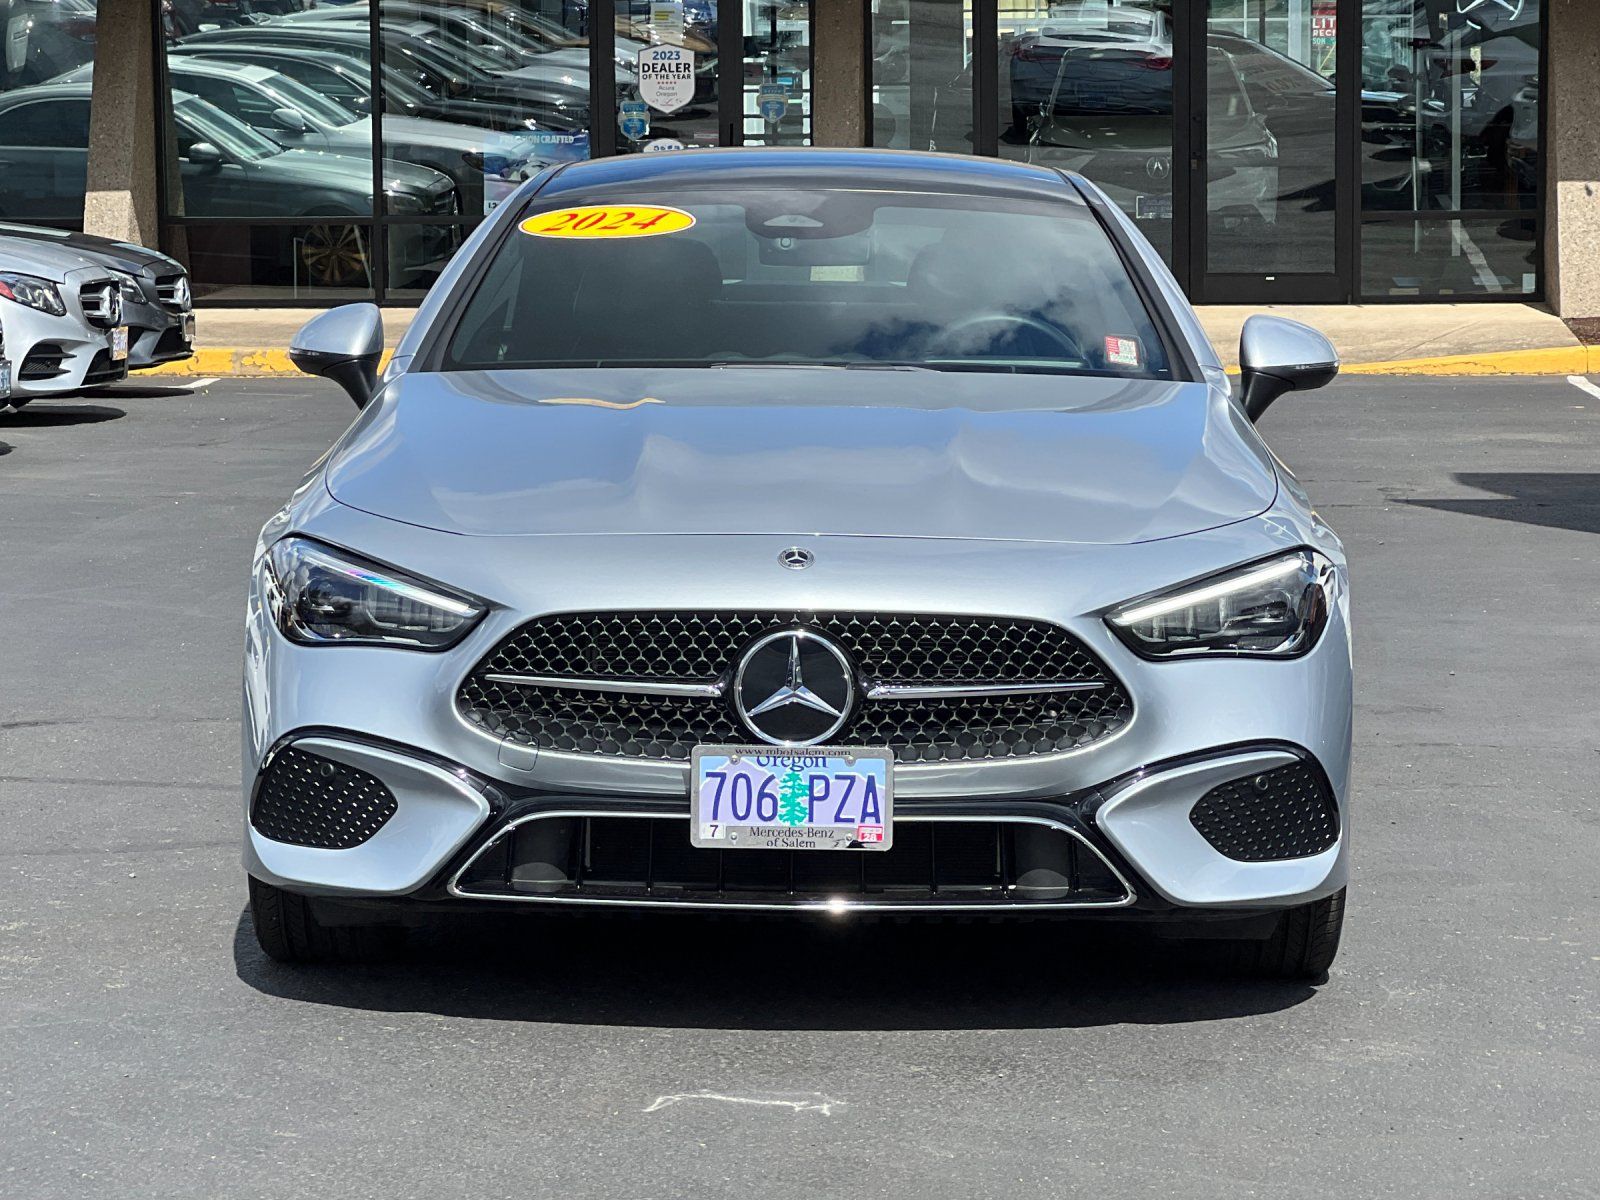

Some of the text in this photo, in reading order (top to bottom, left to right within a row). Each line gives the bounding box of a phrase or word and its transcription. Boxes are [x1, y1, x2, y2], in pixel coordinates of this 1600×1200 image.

[652, 50, 681, 61] 2023
[641, 62, 691, 74] DEALER
[655, 91, 677, 99] Oregon
[540, 135, 575, 144] CRAFTED
[540, 211, 671, 232] 2024
[706, 771, 881, 824] 706 PZA
[709, 824, 719, 838] 7
[749, 826, 835, 838] Mercedes-Benz
[766, 838, 816, 848] of Salem
